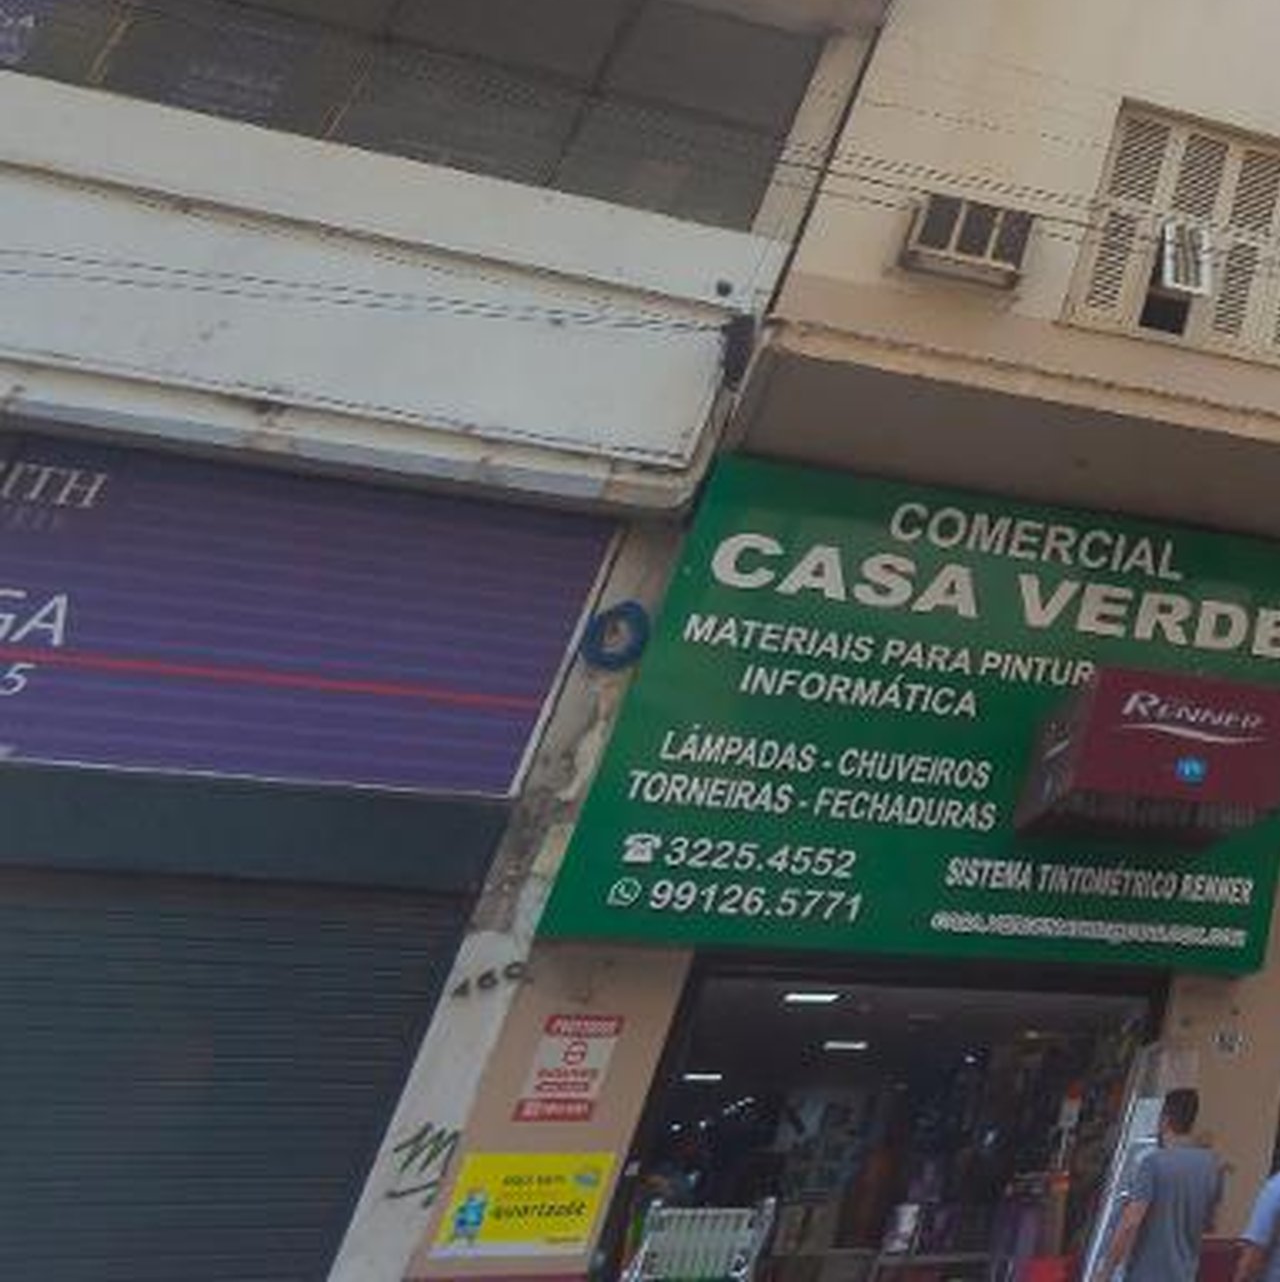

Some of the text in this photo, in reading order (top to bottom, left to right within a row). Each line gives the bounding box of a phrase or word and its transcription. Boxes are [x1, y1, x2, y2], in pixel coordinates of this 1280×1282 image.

[0, 461, 108, 509] ITH
[890, 503, 1183, 581] COMERCIAL
[711, 533, 978, 617] CASA
[683, 613, 1096, 687] MATERIAIS PARA PINTUR
[739, 664, 978, 718] INFORMÁTICA
[837, 748, 992, 790] CHUVEIROS
[626, 770, 794, 815] TORNEIRAS
[813, 787, 997, 832] FECHADURAS
[664, 835, 857, 879] 3225.4552
[945, 856, 1254, 905] SISTEMA TINTOMÉTRICO RENNER
[649, 879, 864, 922] 99126.5771
